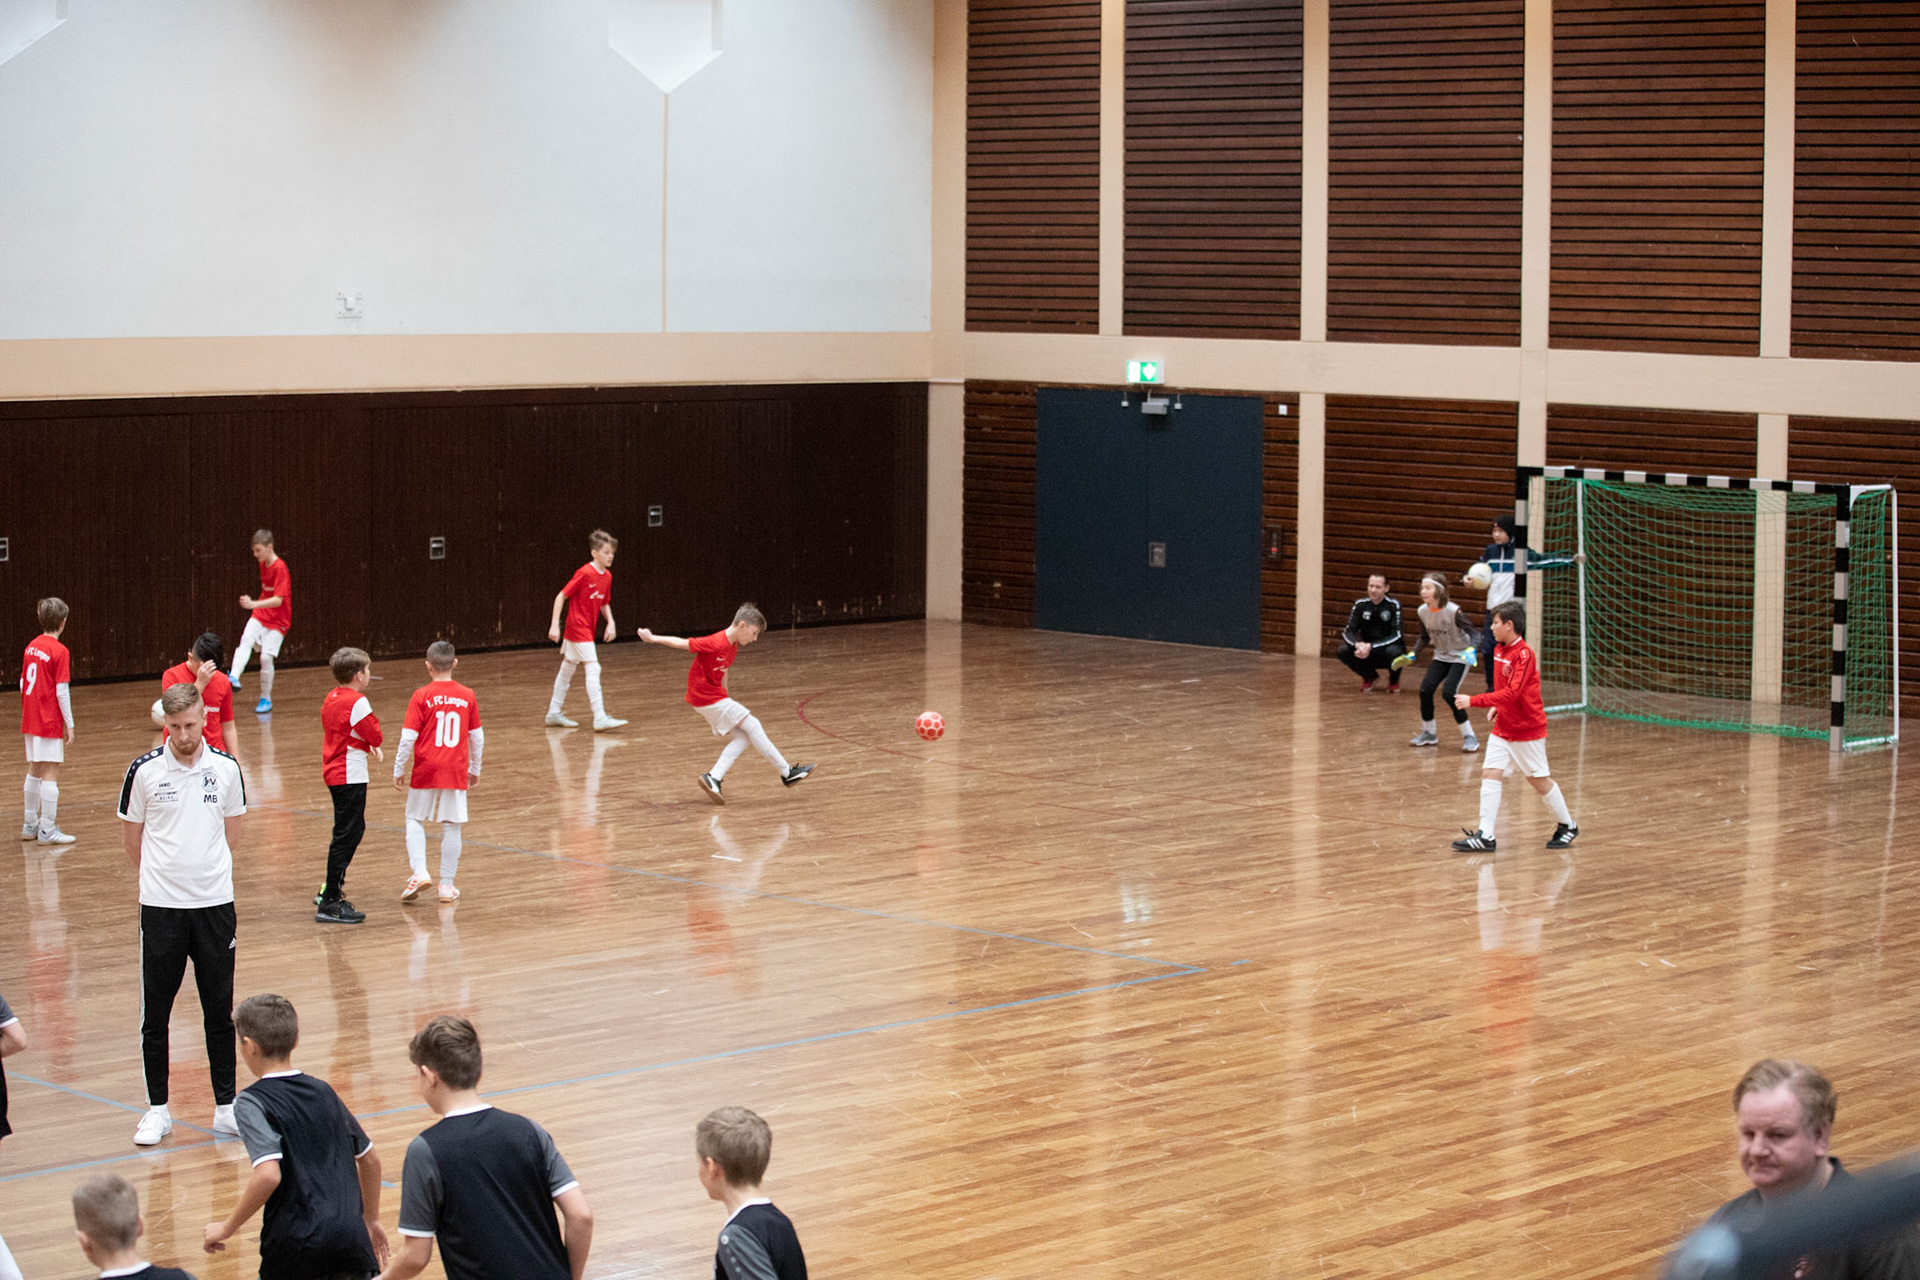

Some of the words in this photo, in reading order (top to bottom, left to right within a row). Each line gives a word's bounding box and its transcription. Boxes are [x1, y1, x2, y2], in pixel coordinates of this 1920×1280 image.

[25, 662, 37, 695] 9
[433, 695, 444, 705] FC
[435, 711, 460, 748] 10
[204, 794, 218, 804] MB
